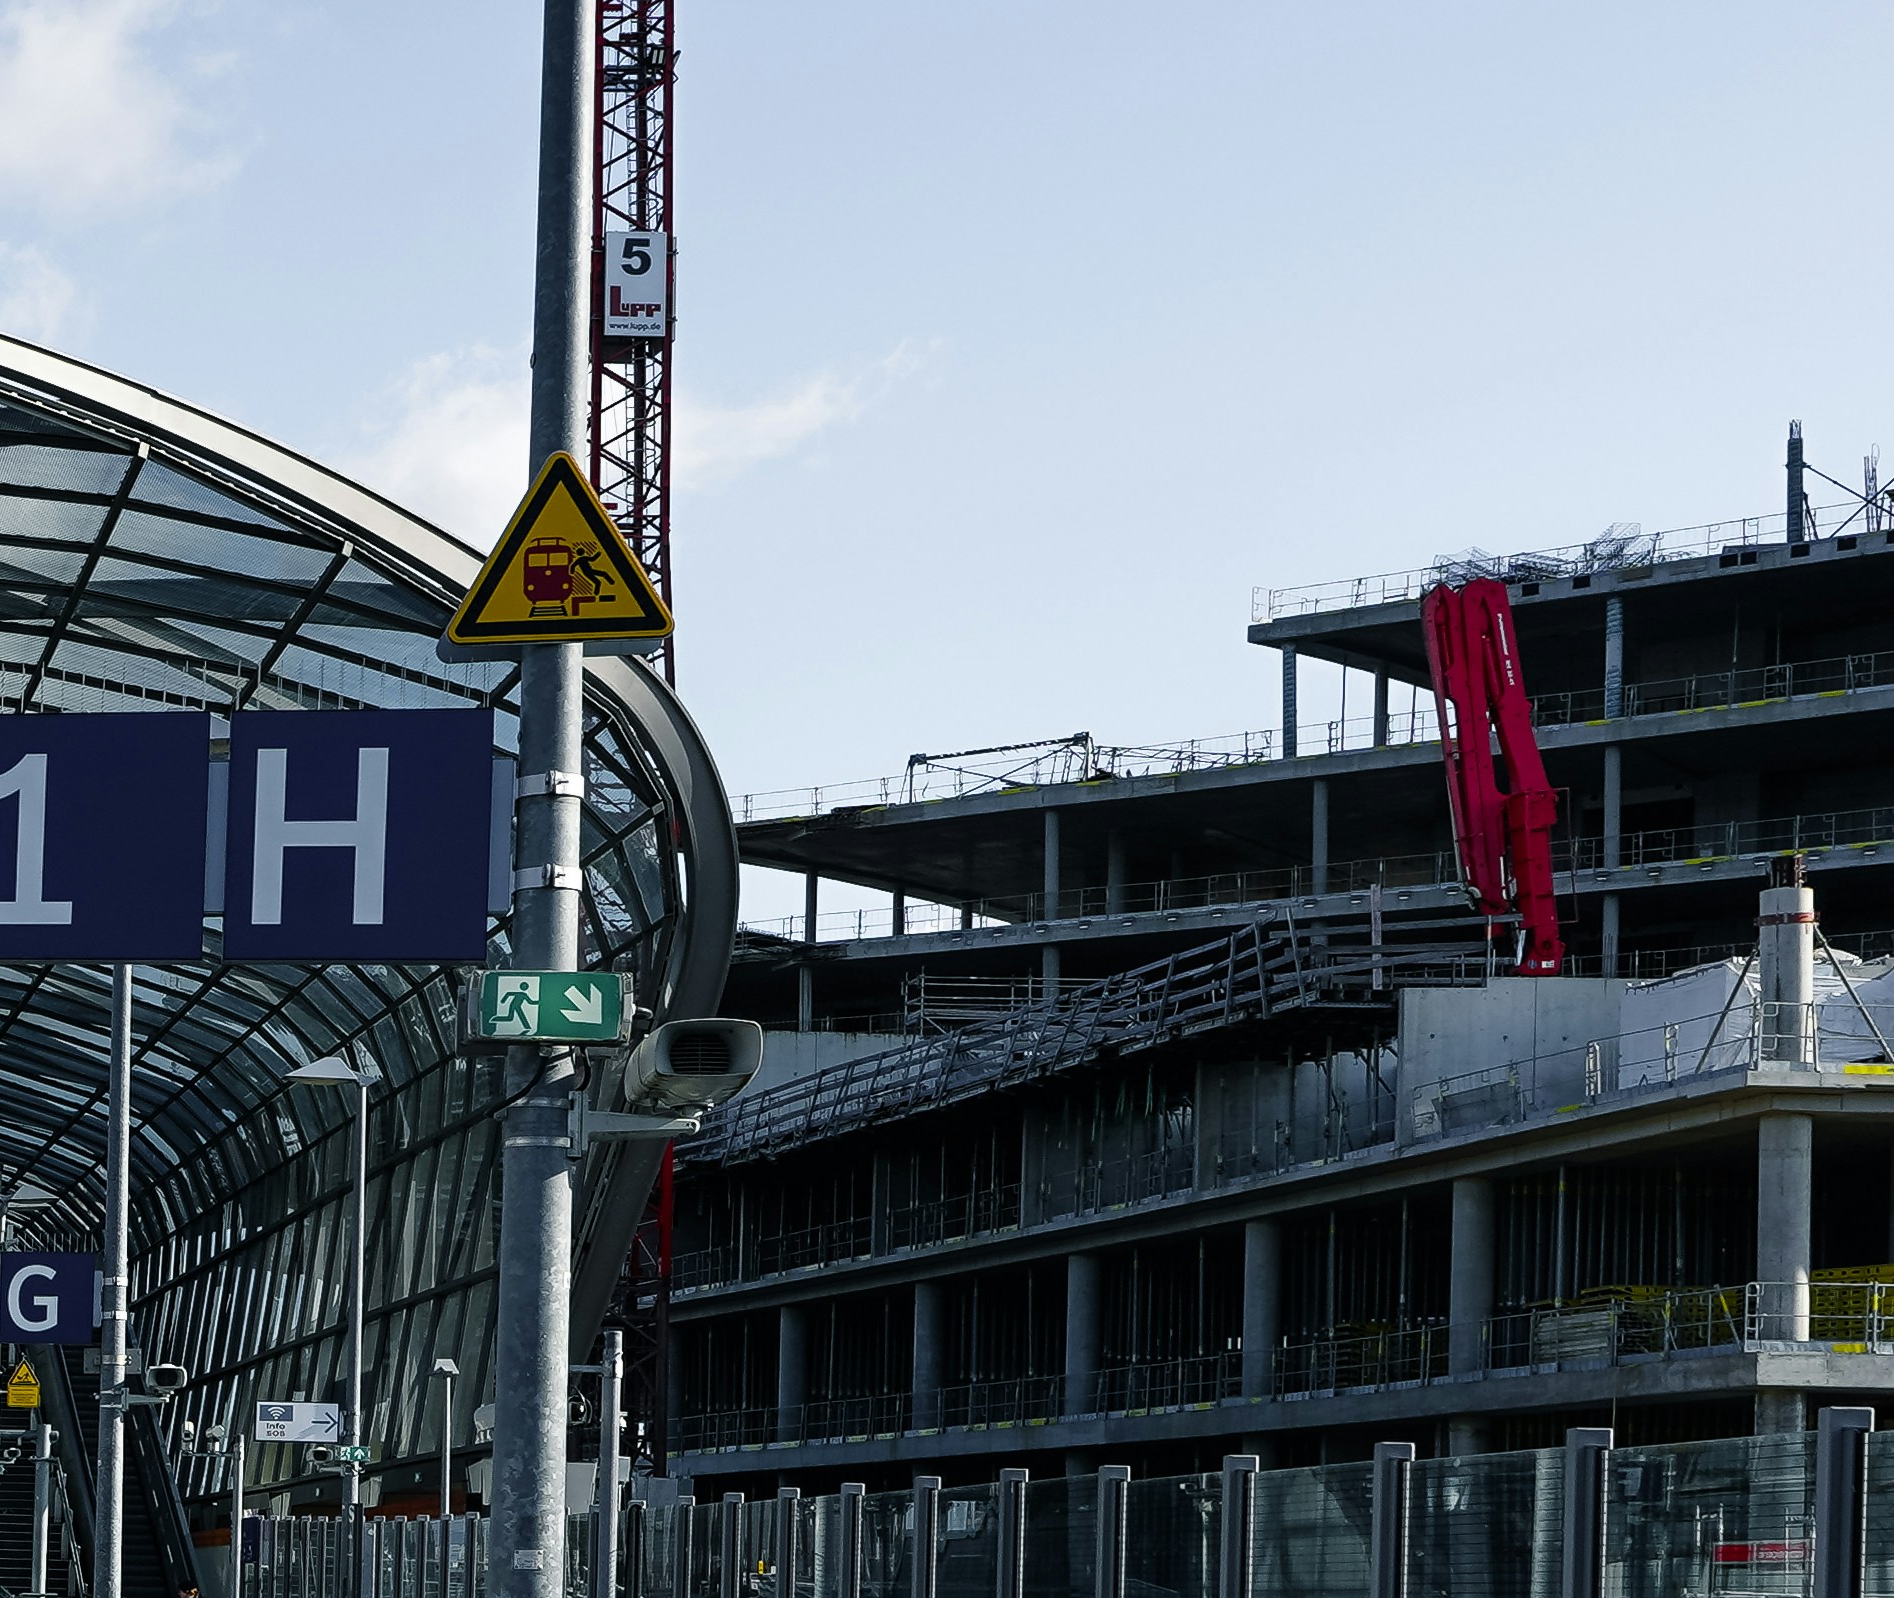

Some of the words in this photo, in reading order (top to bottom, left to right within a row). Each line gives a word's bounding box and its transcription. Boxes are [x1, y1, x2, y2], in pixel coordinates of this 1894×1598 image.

[621, 238, 652, 275] 5
[609, 322, 661, 332] www.lupp.de
[251, 747, 390, 925] H
[8, 1264, 58, 1332] G
[266, 1422, 286, 1430] Info
